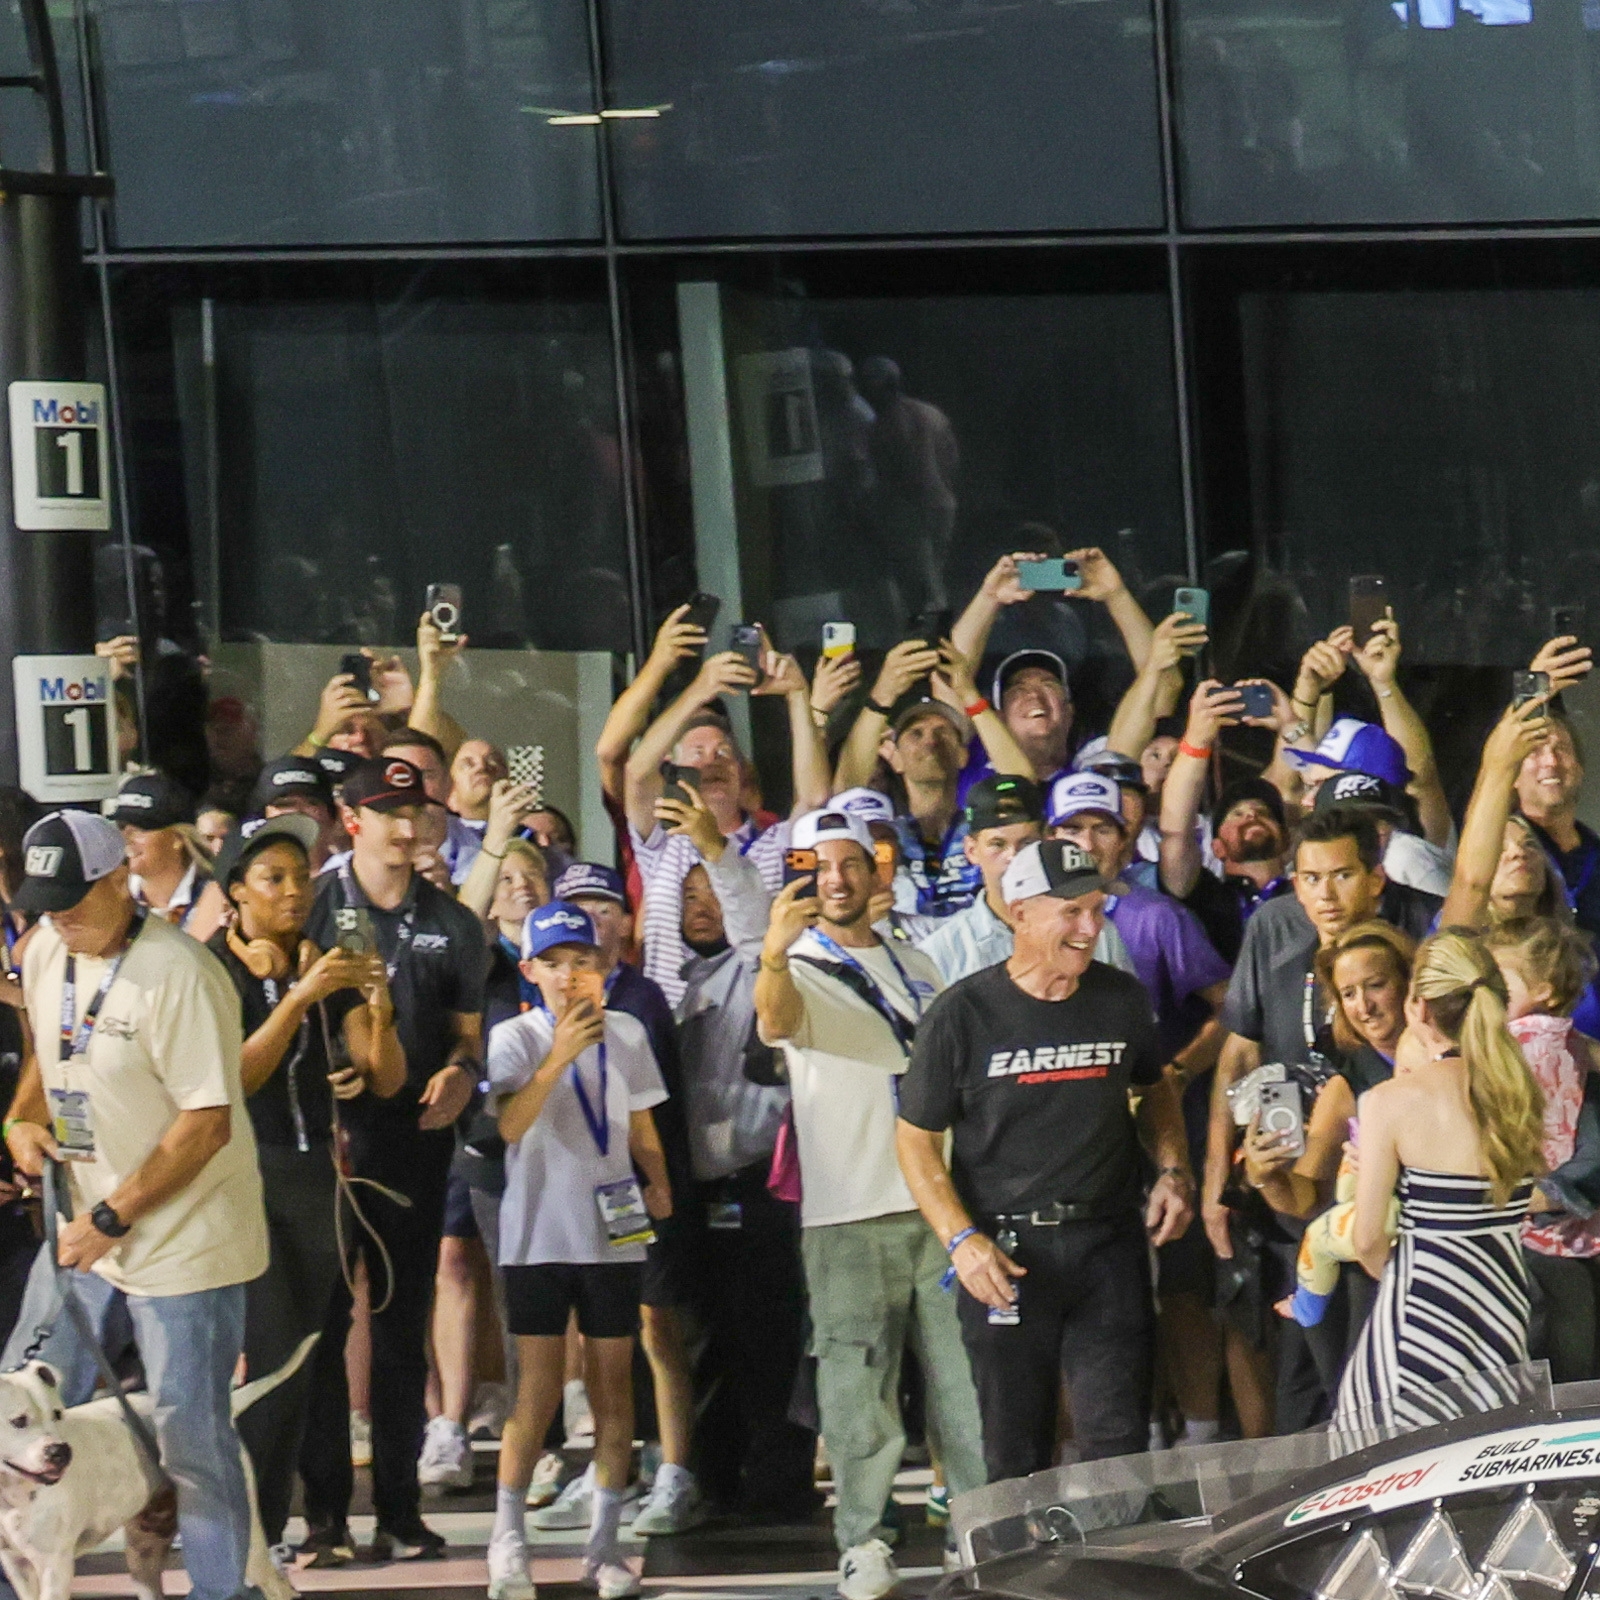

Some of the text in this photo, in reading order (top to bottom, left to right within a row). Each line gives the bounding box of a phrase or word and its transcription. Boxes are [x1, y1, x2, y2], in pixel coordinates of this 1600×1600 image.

[56, 430, 83, 497] 1
[63, 707, 92, 771] 1
[987, 1041, 1128, 1079] EARNEST
[1476, 1437, 1540, 1461] BUILD
